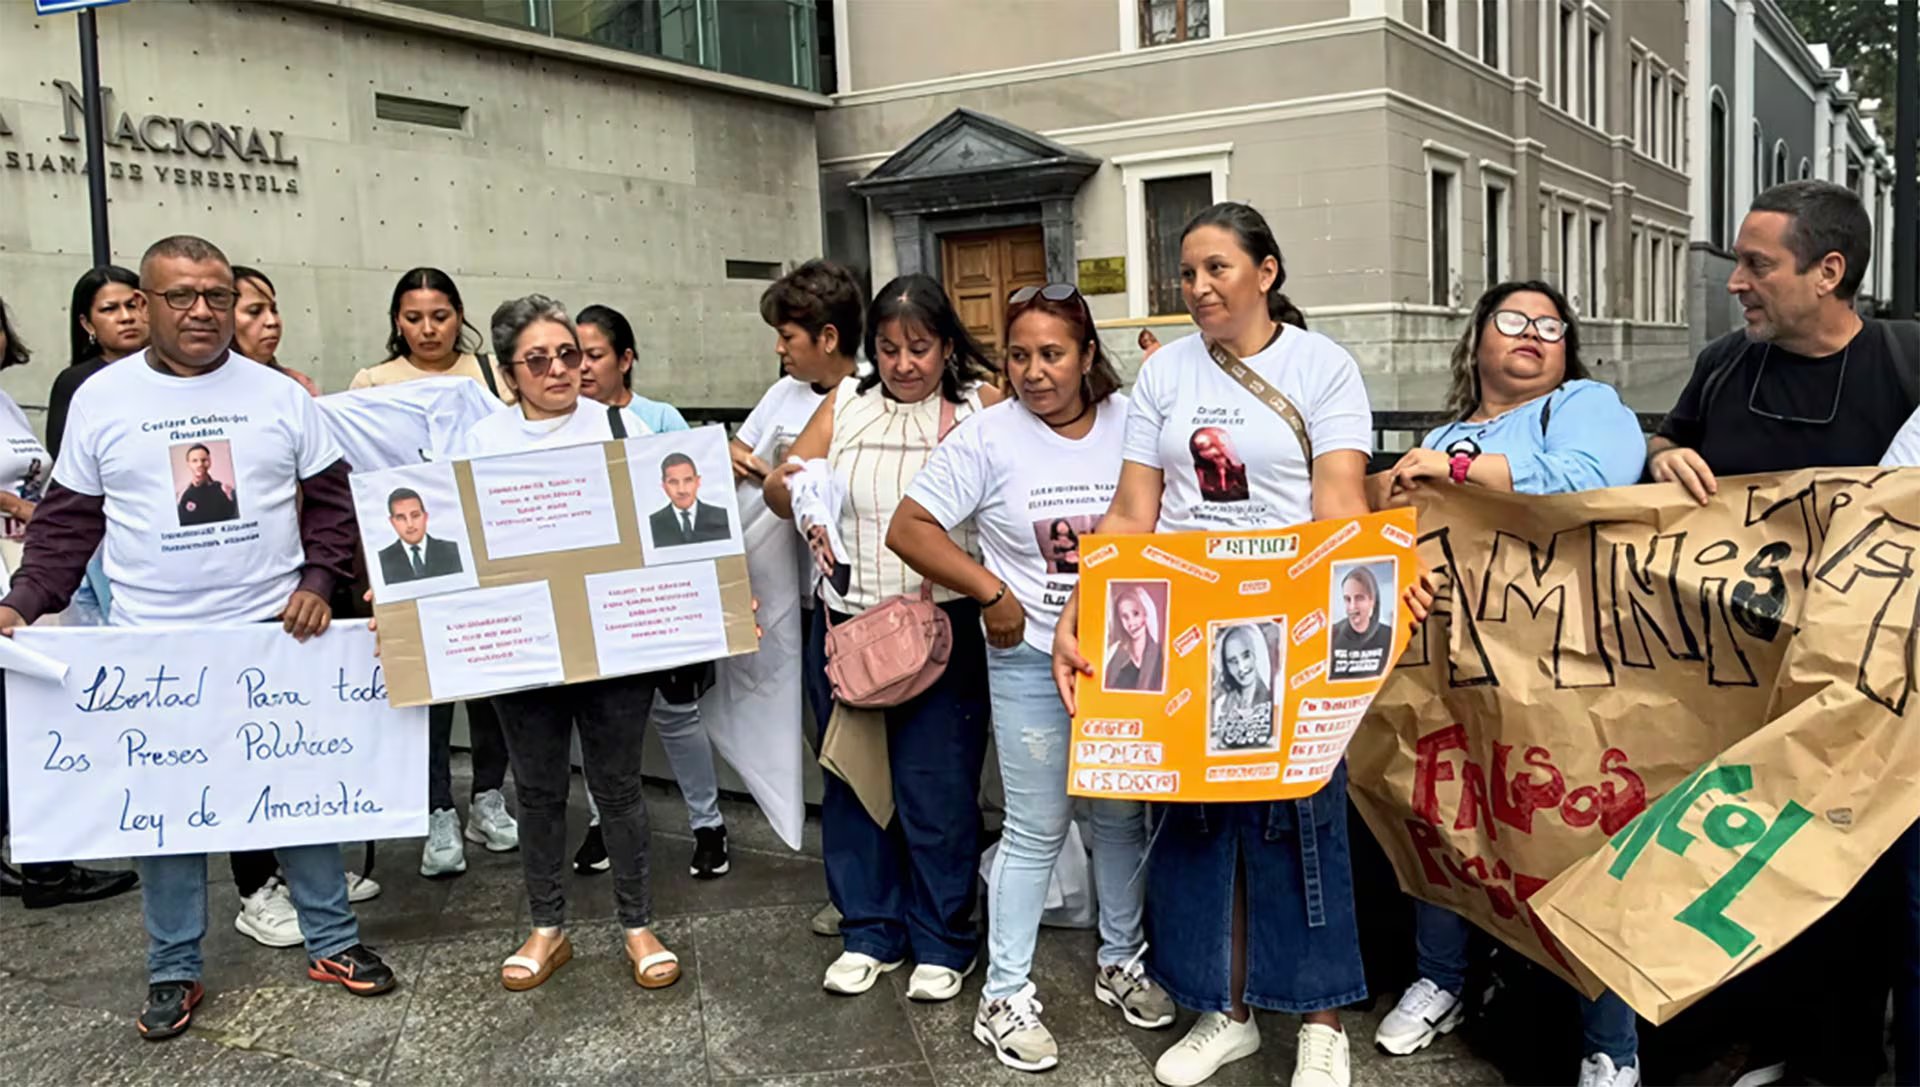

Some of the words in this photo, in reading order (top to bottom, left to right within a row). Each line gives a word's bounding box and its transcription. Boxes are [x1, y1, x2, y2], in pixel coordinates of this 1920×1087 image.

[237, 668, 310, 708] Para
[44, 731, 91, 772] Los
[120, 788, 163, 847] Ley
[188, 785, 219, 827] de
